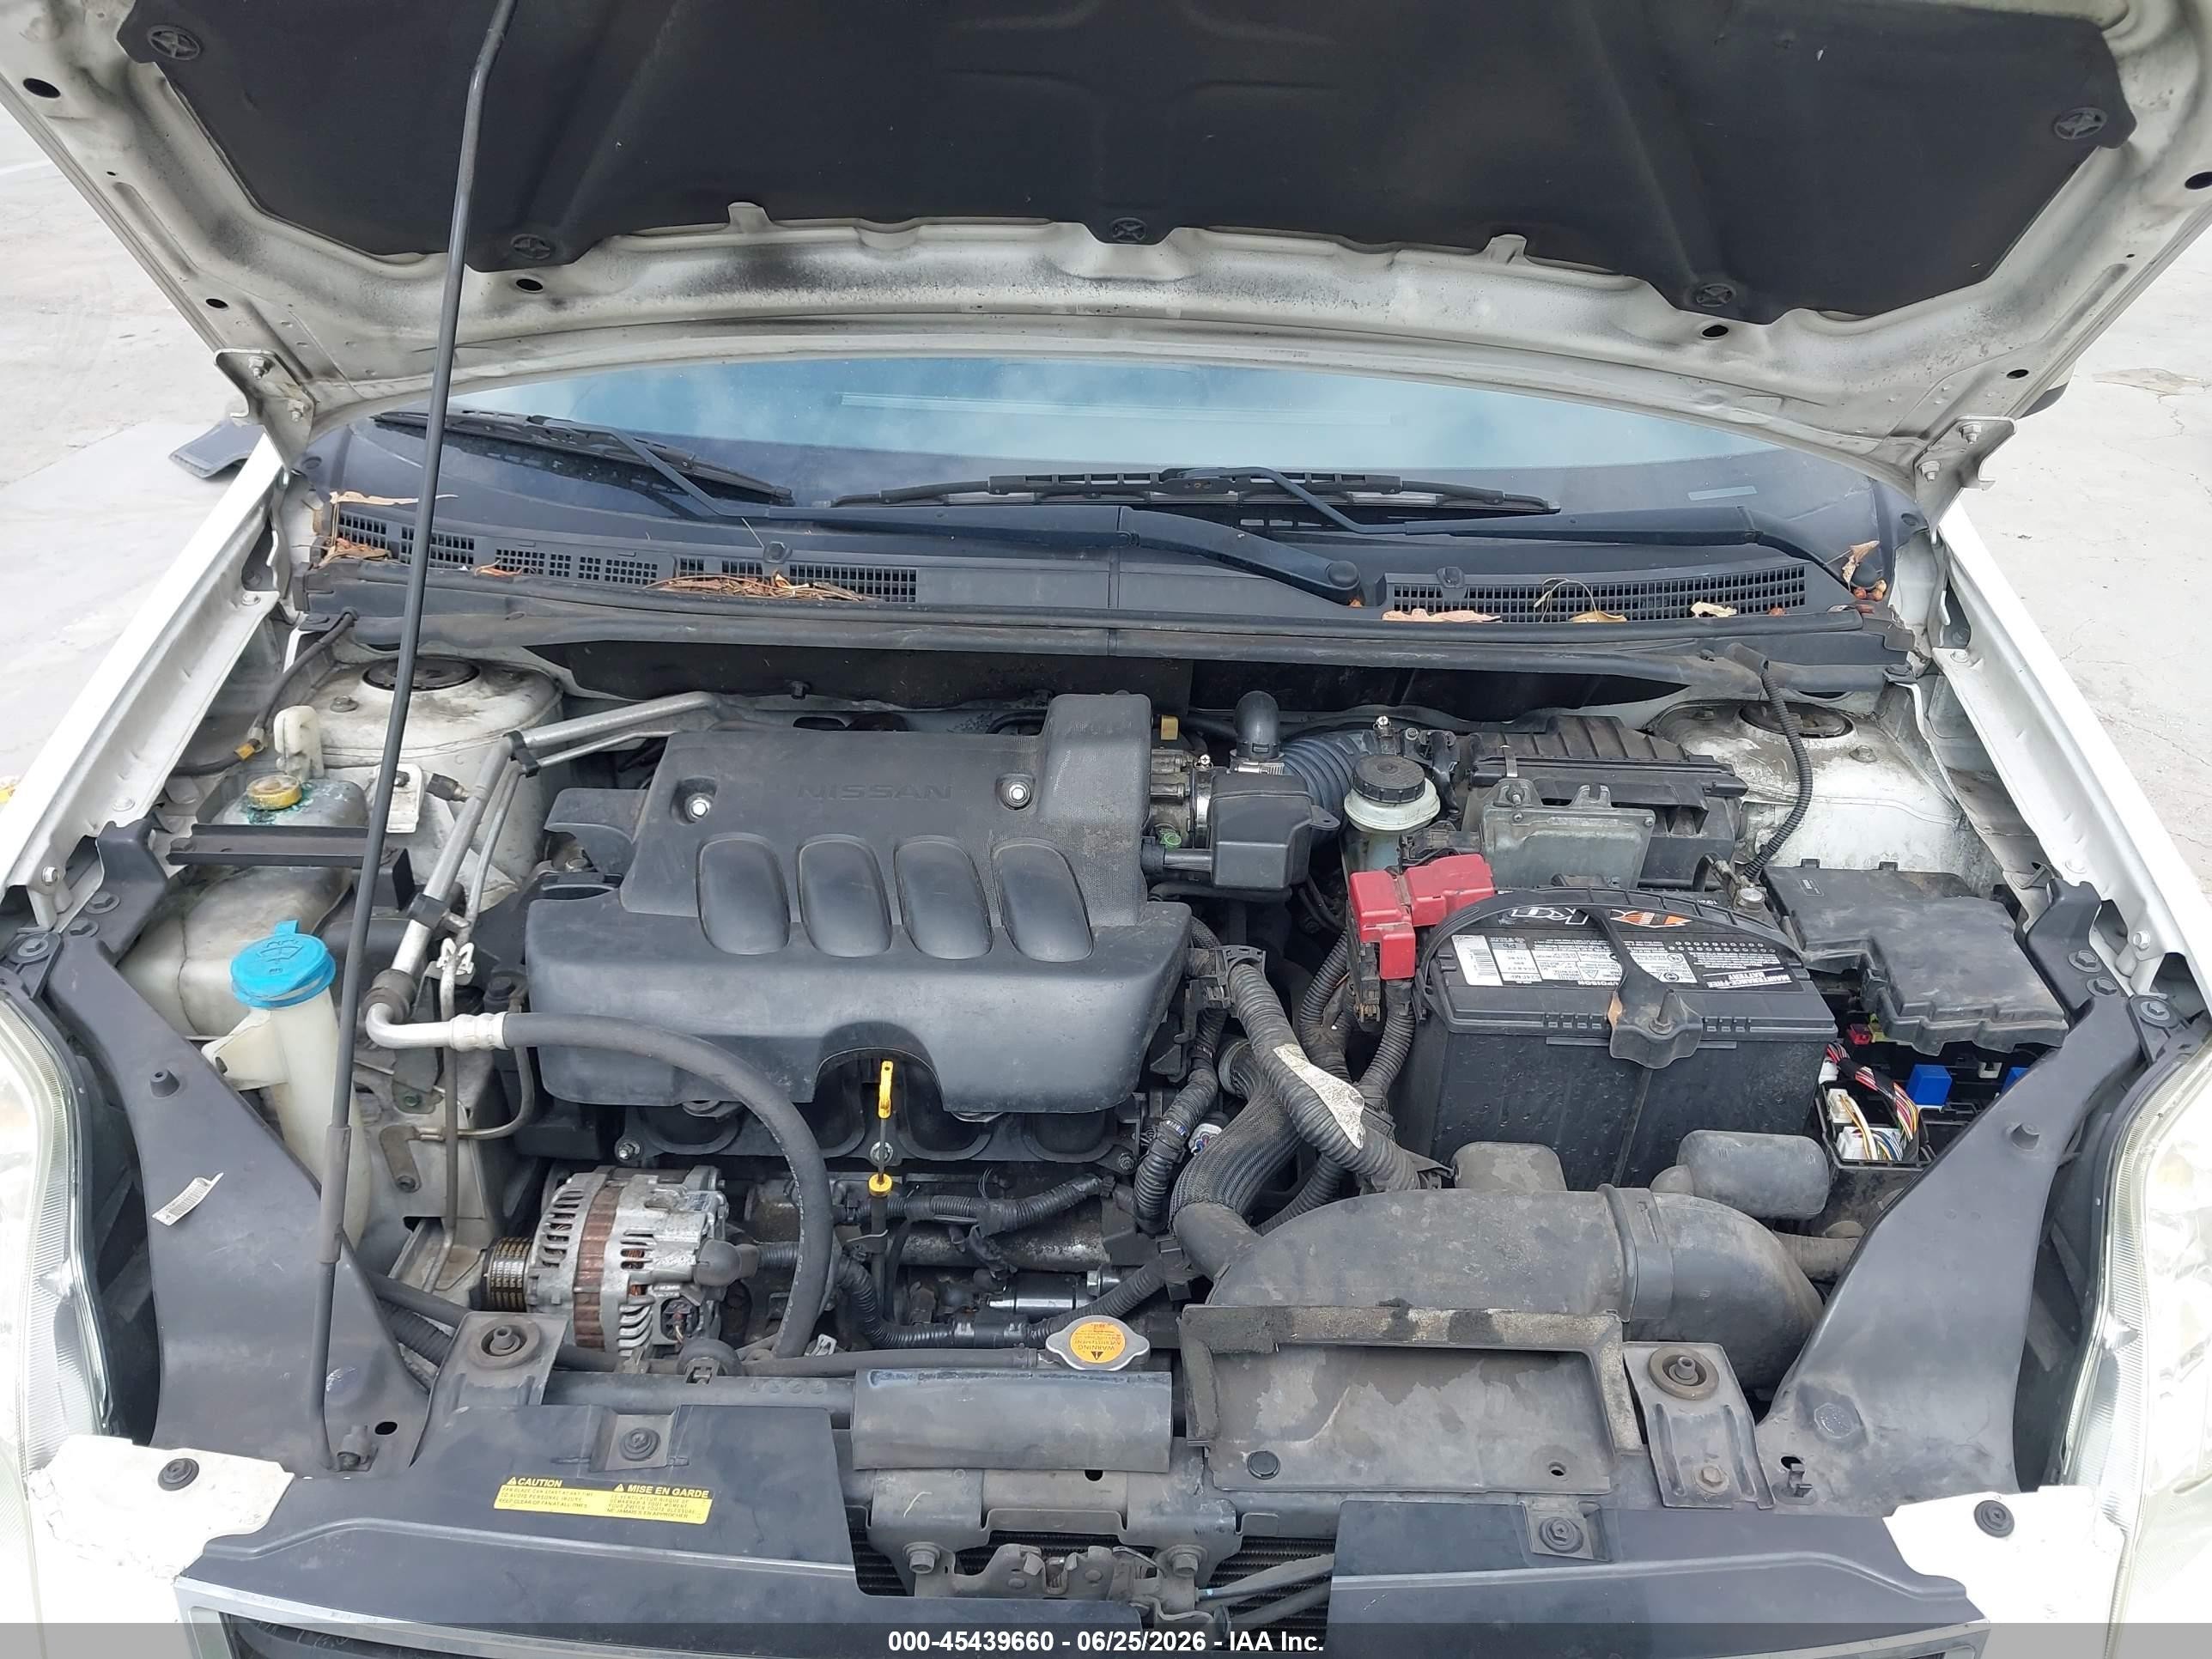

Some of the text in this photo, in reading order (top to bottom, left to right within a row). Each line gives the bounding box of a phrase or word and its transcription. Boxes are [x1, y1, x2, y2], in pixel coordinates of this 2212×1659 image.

[797, 783, 954, 801] NISSAN
[1706, 974, 1791, 988] MAINTENANCE-FREE
[1728, 971, 1765, 980] BATTERY
[518, 1478, 563, 1487] CAUTION
[628, 1484, 709, 1498] MISE EN GARDE
